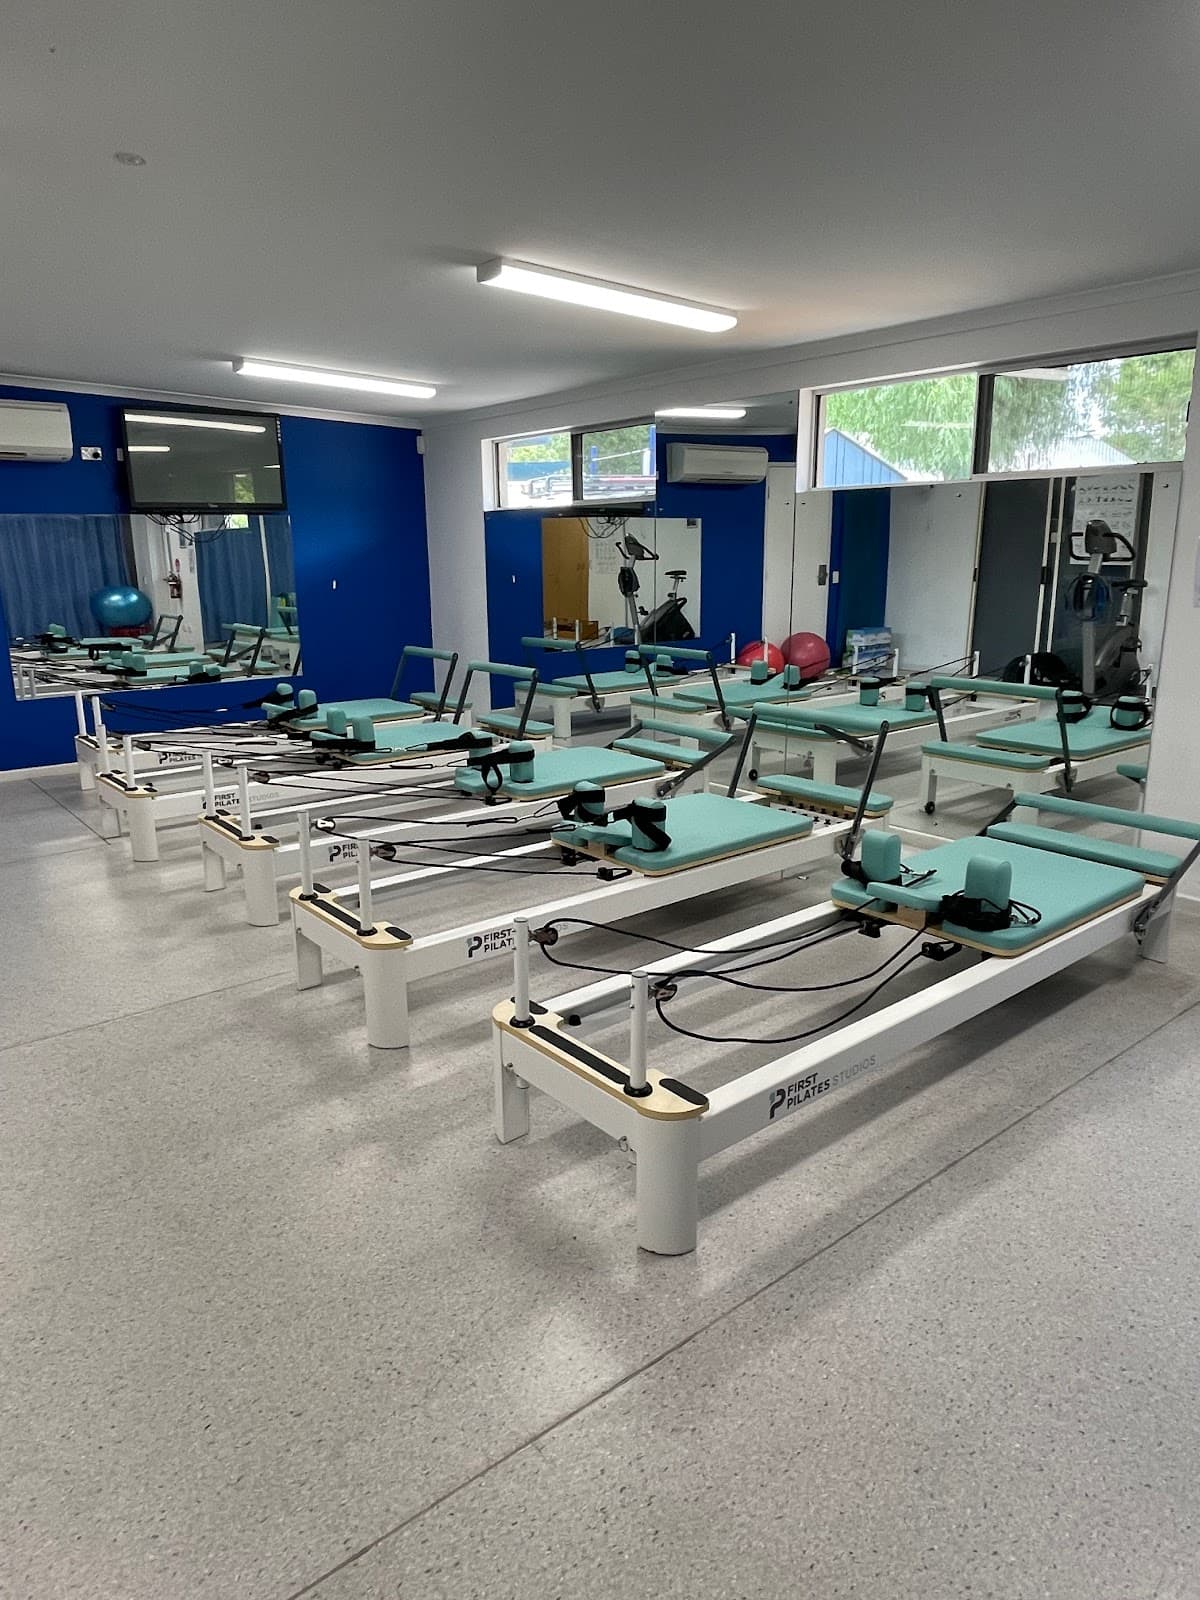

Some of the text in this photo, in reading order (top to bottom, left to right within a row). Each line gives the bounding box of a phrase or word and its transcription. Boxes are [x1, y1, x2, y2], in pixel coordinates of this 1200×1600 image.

[214, 793, 236, 801] FIRST
[342, 843, 359, 852] FIR
[483, 928, 513, 943] FIRST
[484, 938, 515, 953] PILAT
[787, 1054, 878, 1110] PILATES STUDIOS
[787, 1072, 819, 1097] FIRST
